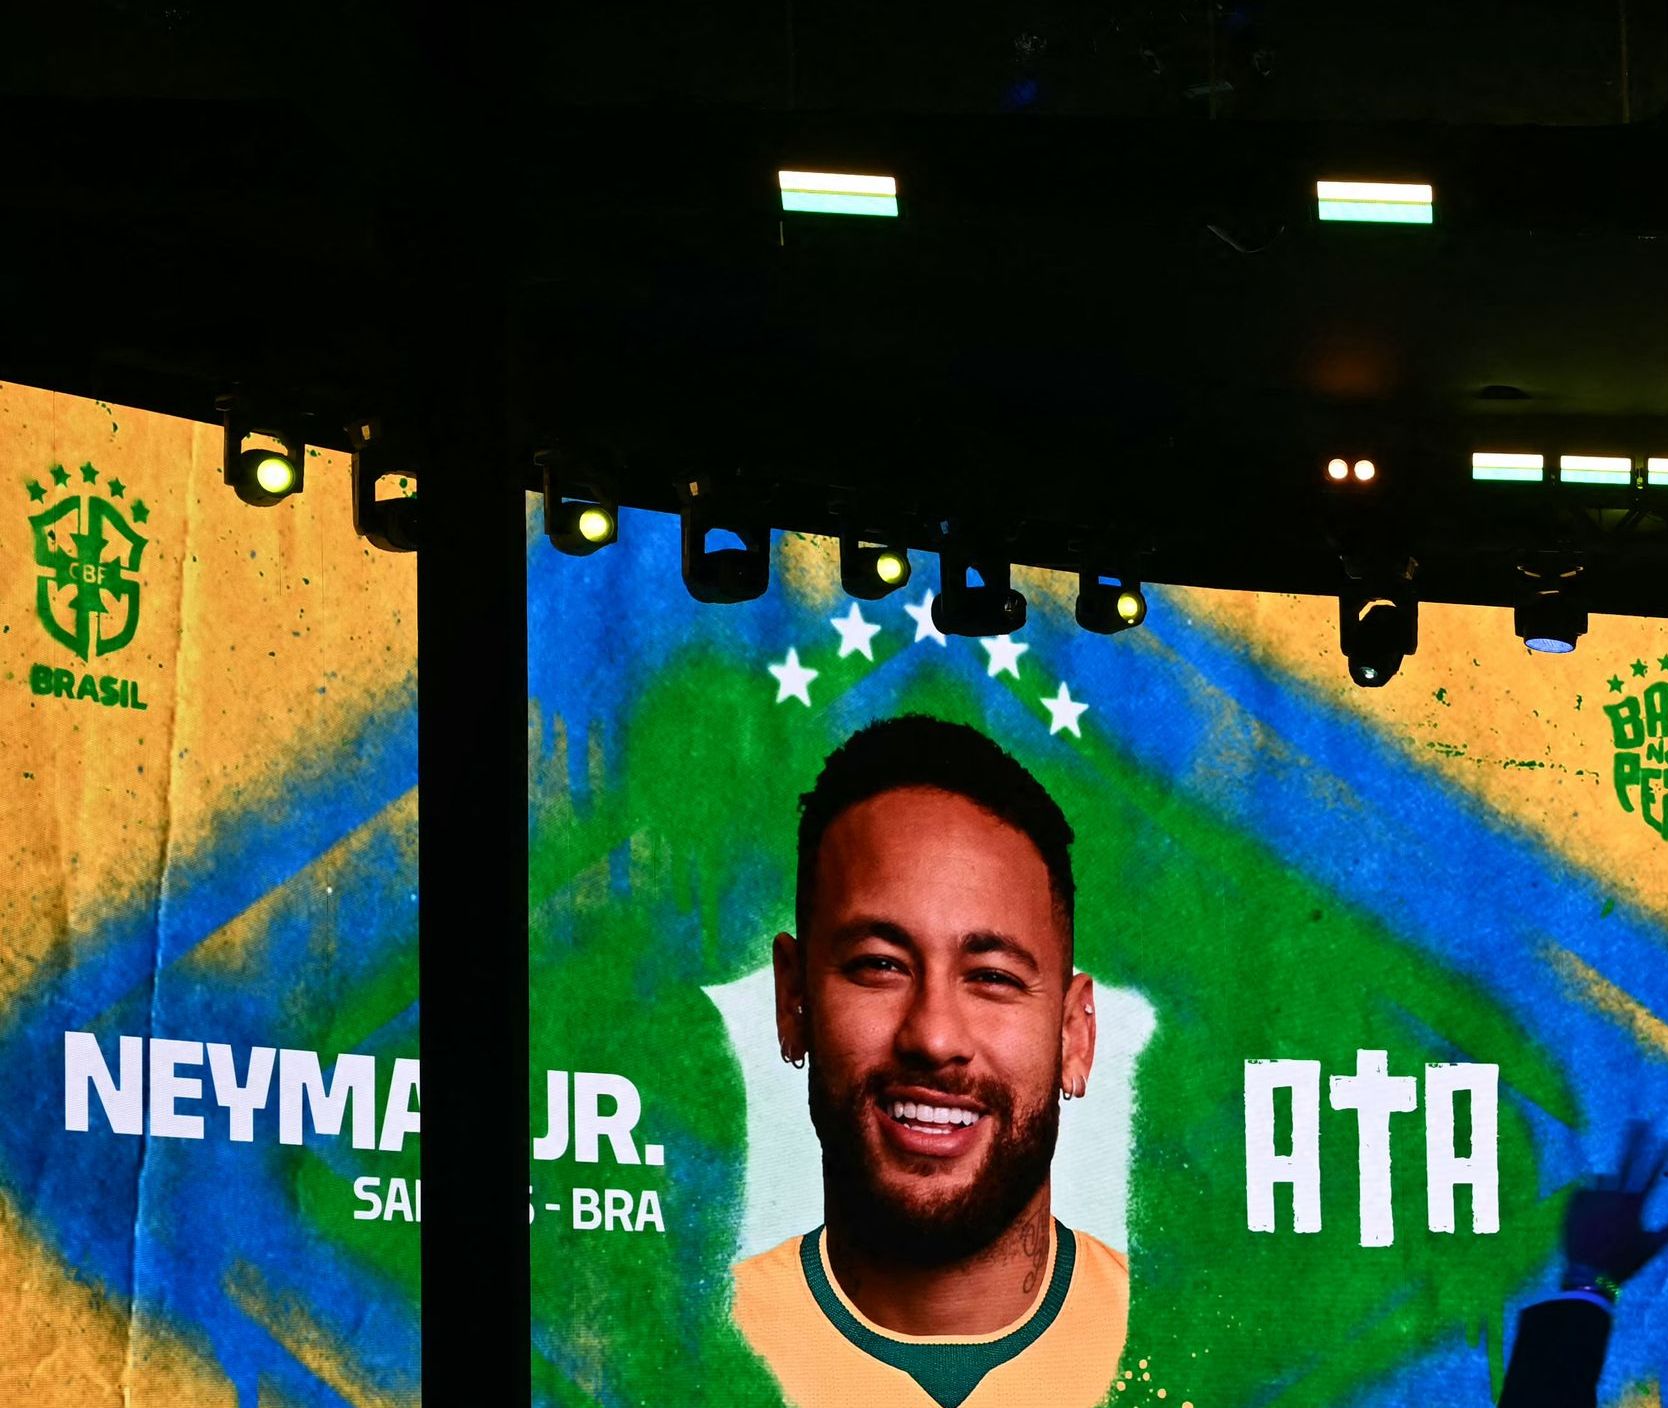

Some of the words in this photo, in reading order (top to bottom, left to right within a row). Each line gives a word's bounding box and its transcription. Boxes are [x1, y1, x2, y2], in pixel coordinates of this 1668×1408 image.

[30, 664, 148, 710] BRASIL
[65, 1031, 420, 1152] NEYMA
[532, 1071, 665, 1165] JR.
[1244, 1049, 1499, 1248] ATA
[573, 1188, 665, 1233] BRA
